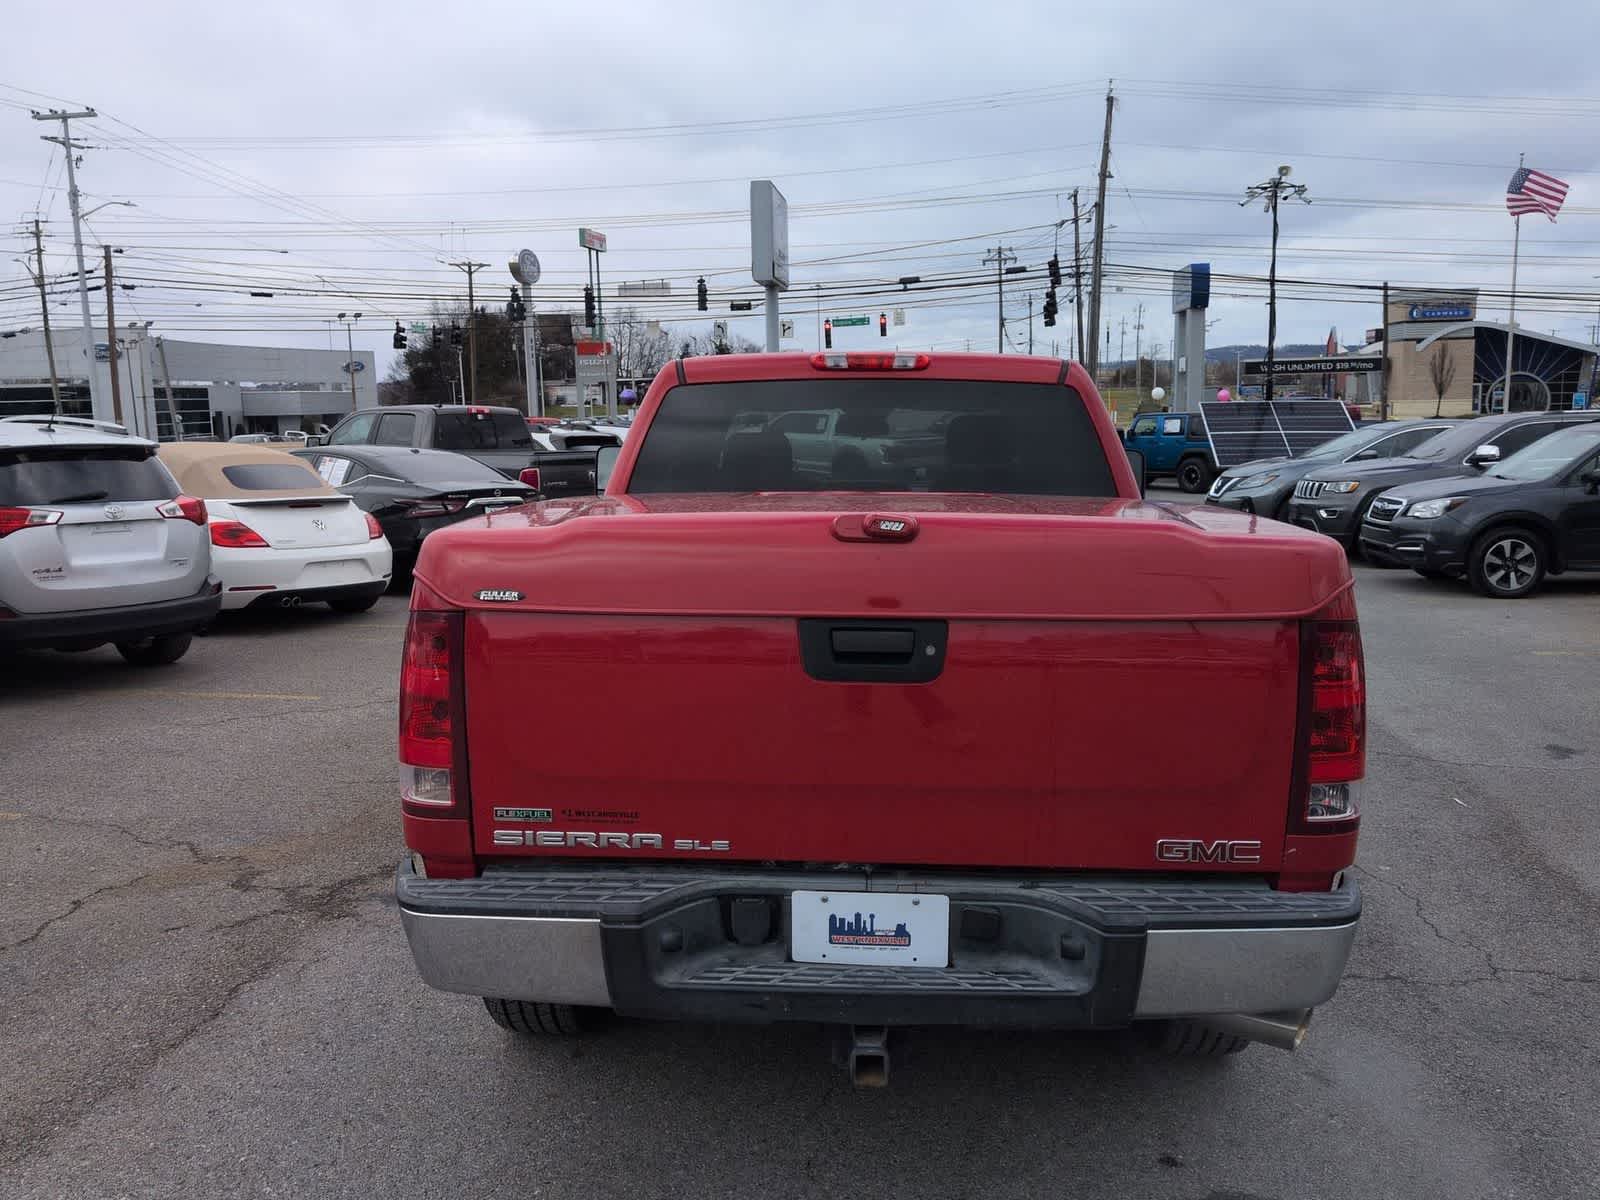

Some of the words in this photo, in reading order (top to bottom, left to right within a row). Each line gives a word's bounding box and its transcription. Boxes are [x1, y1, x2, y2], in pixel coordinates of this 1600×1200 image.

[1260, 363, 1286, 372] WSH
[1287, 362, 1333, 371] UNLIMITED
[493, 830, 663, 849] SIERRA
[674, 839, 730, 850] SLE
[1156, 838, 1262, 864] GMC
[831, 935, 856, 943] WEST
[857, 936, 909, 945] KNOXVILLE
